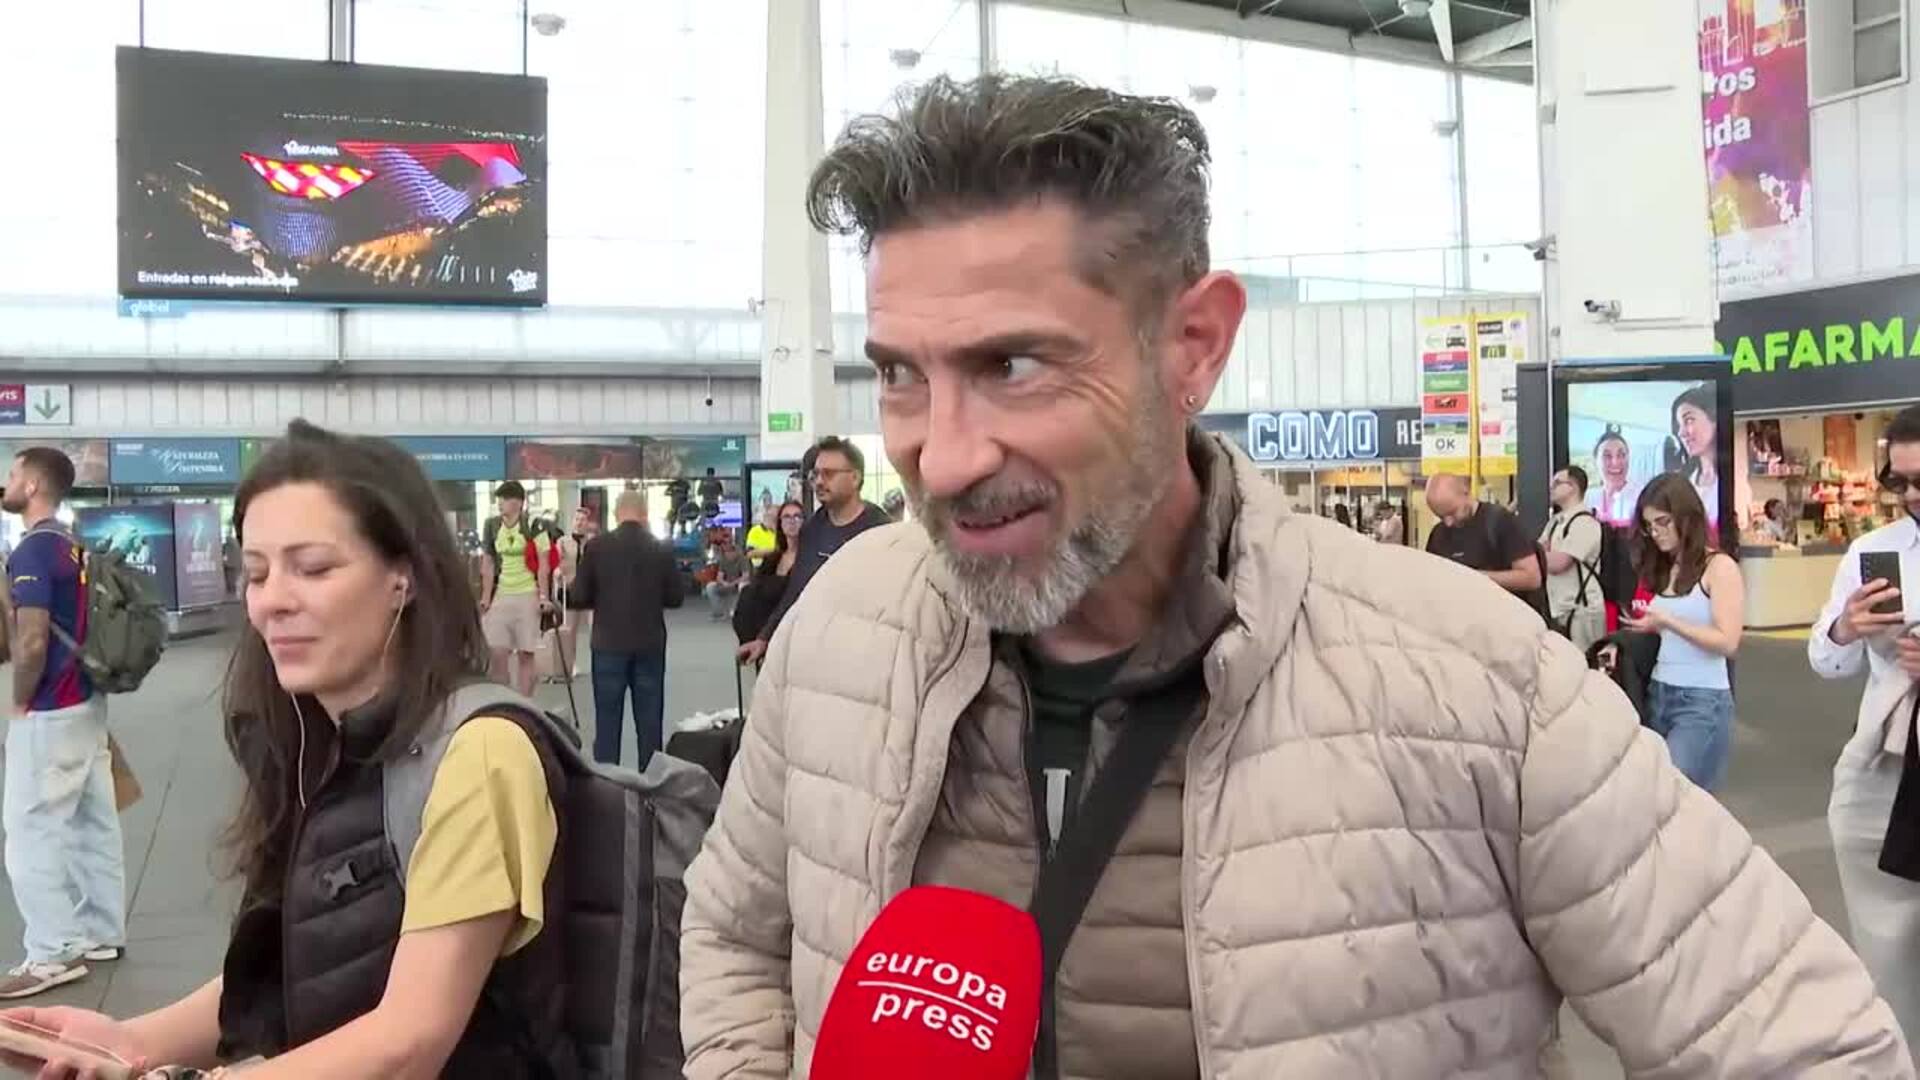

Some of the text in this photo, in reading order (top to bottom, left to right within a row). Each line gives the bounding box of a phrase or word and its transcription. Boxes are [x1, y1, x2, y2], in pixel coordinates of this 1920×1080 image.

[137, 271, 190, 284] Entradas
[191, 275, 207, 284] en
[1713, 317, 1920, 375] AFARM
[1248, 411, 1379, 460] COMO
[1435, 438, 1456, 451] OK
[866, 951, 1007, 1010] europa
[871, 993, 994, 1051] press
